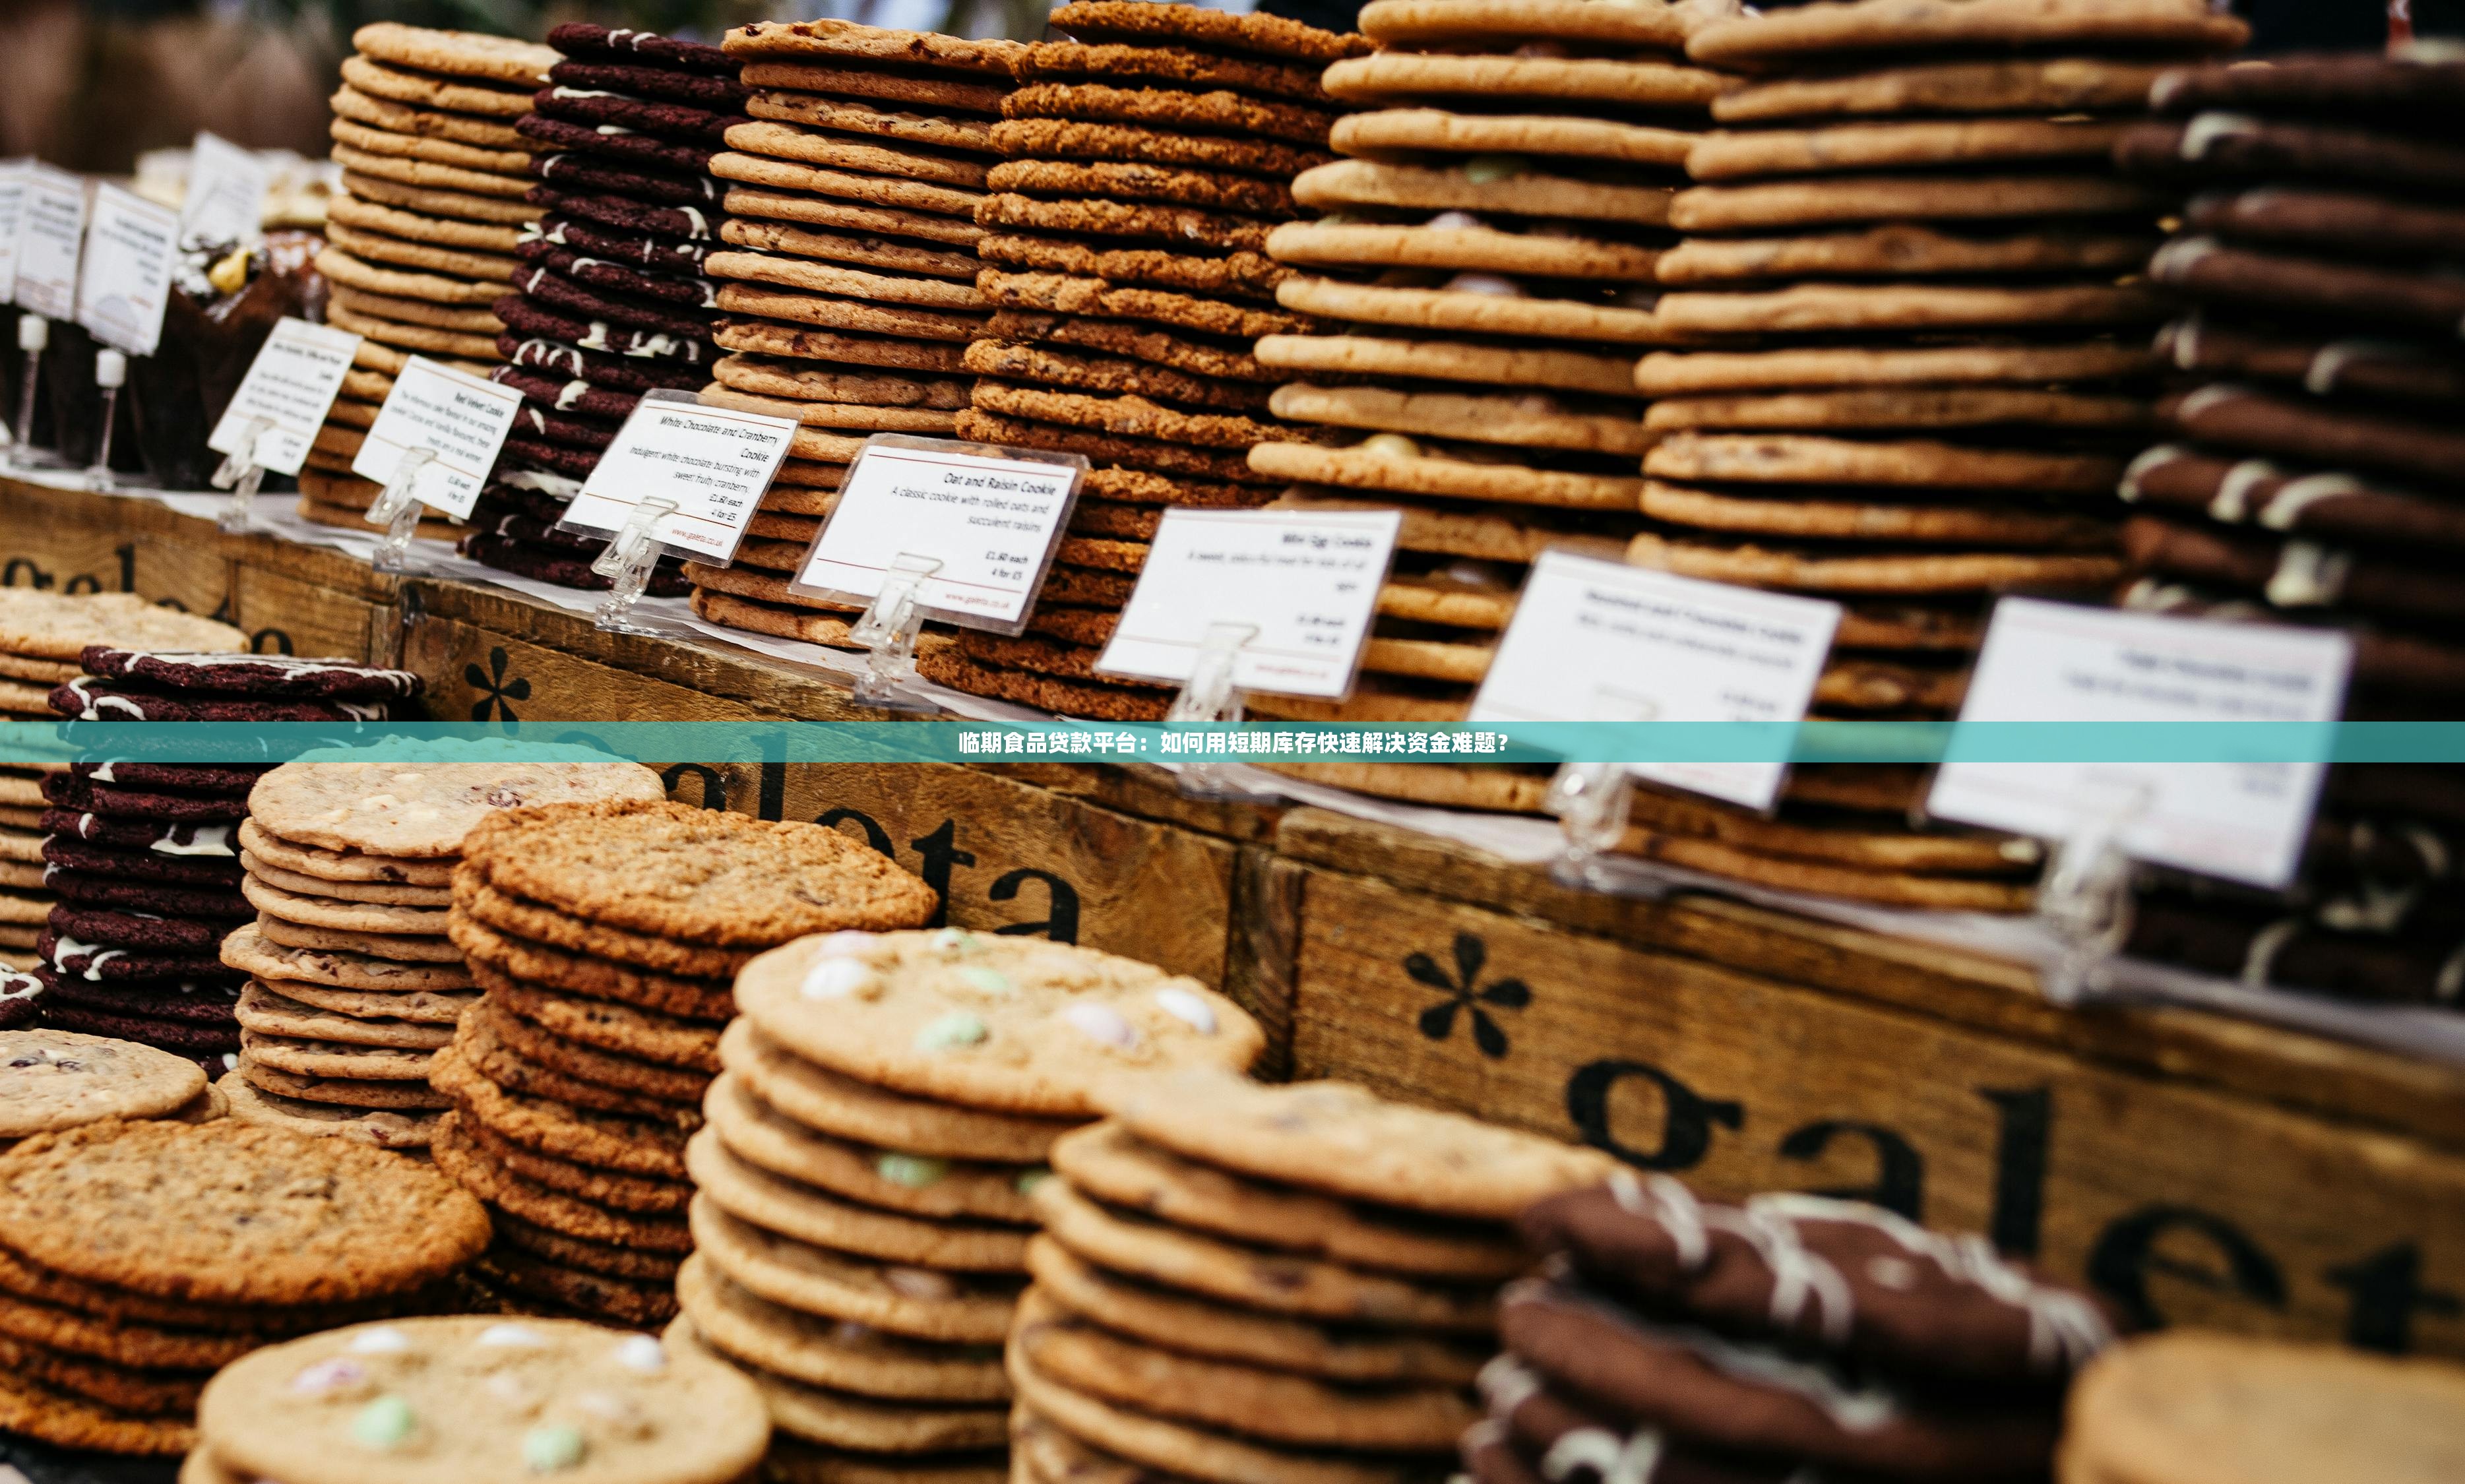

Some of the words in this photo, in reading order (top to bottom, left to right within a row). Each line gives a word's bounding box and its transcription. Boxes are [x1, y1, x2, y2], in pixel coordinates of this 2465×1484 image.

[660, 416, 683, 428] White
[683, 419, 722, 434] Chocolate
[738, 429, 780, 447] Cranberry
[629, 447, 662, 459] Indulgent
[661, 452, 680, 462] white
[680, 456, 713, 469] chocolate
[713, 462, 743, 477] bursting
[744, 468, 761, 478] with
[740, 448, 769, 462] Cookie
[673, 472, 695, 481] sweet
[695, 476, 716, 486] fruity
[987, 477, 1018, 490] Raisin
[1020, 481, 1056, 496] Cookie
[899, 488, 928, 500] classic
[929, 493, 958, 504] cookie
[960, 496, 980, 506] with
[983, 498, 1009, 510] rolled
[1010, 503, 1030, 512] oats
[967, 516, 1012, 528] succulent
[1013, 522, 1042, 533] raisins
